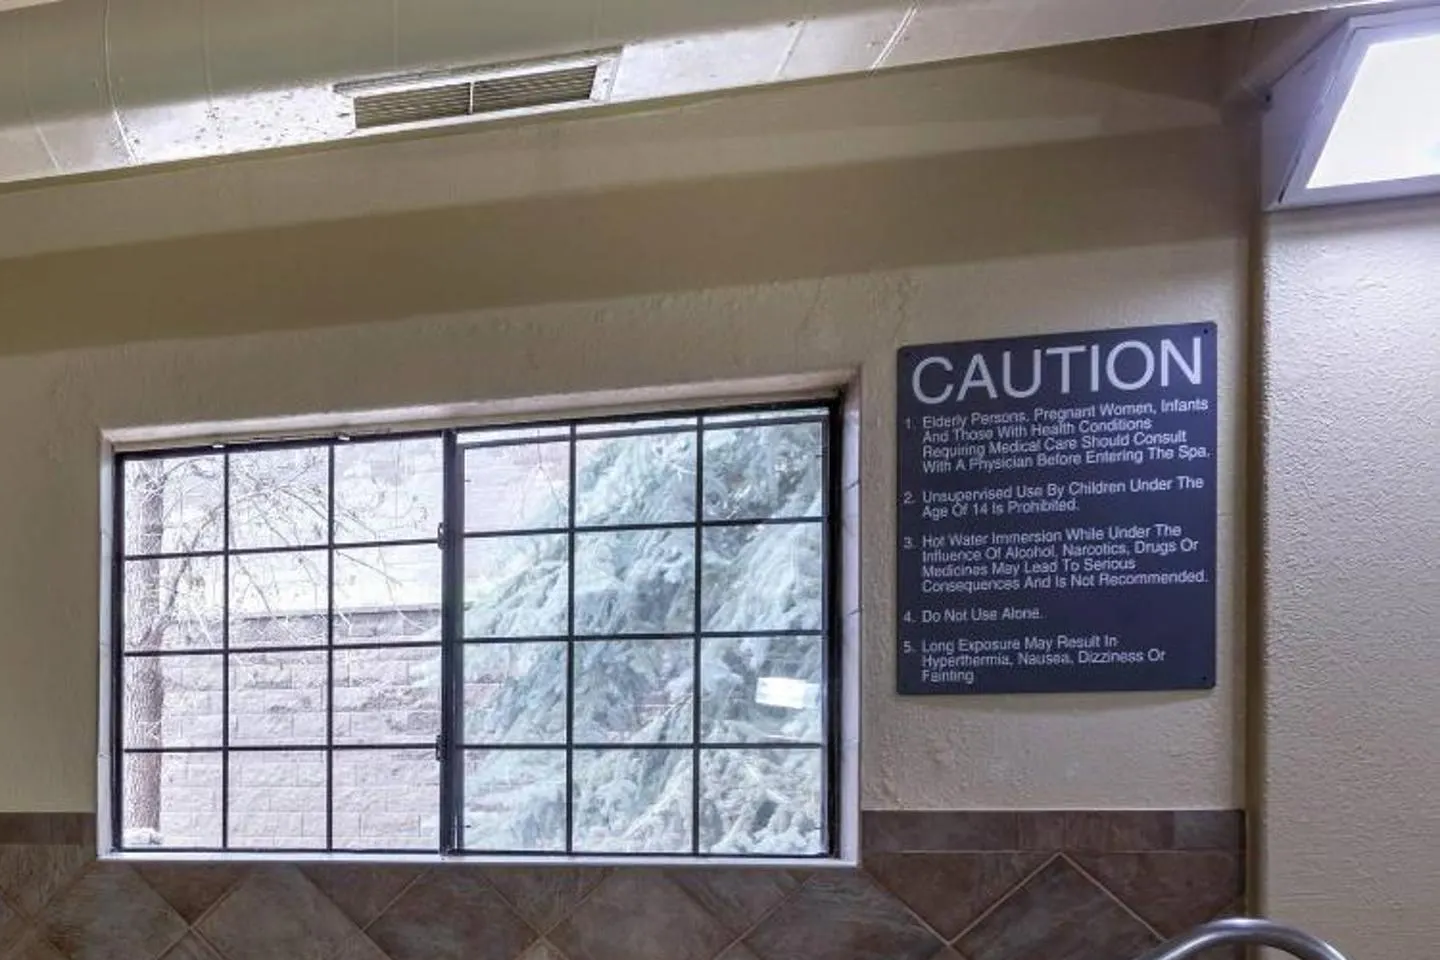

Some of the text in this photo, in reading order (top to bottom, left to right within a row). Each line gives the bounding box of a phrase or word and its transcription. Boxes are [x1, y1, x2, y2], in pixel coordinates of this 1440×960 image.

[912, 337, 1201, 404] CAUTION
[922, 415, 967, 429] Elderly
[1033, 405, 1096, 421] Pregnant
[1161, 398, 1208, 412] Infants
[922, 418, 1153, 443] And Those With Health Conditions
[922, 430, 1187, 459] Requiring Medical Care Should Consult
[922, 459, 951, 473] With
[956, 459, 966, 471] A
[969, 456, 1033, 472] Physician
[1037, 453, 1082, 467] Before
[1086, 449, 1143, 464] Entering
[1148, 447, 1174, 460] The
[922, 486, 1012, 505] Unsupervised
[1017, 485, 1043, 498] Use
[1047, 483, 1065, 499] By
[1069, 480, 1126, 495] Children
[1130, 478, 1172, 492] Under
[1176, 476, 1205, 489] The
[922, 505, 949, 521] Age
[951, 503, 969, 517] Of
[973, 503, 988, 515] 14
[992, 503, 1004, 515] Is
[922, 535, 945, 548] Hot
[948, 533, 989, 546] Water
[992, 530, 1062, 544] Immersion
[1066, 527, 1105, 541] While
[1108, 526, 1151, 540] Under
[1155, 523, 1182, 537] The
[922, 549, 982, 563] Influence
[985, 546, 1001, 560] Of
[1134, 540, 1177, 556] Drugs
[1180, 537, 1199, 552] Or
[922, 557, 1136, 578] Medicines May Lead To Serious
[922, 577, 1020, 594] Consequences
[1023, 575, 1051, 589] And
[1056, 575, 1067, 588] Is
[1071, 573, 1095, 587] Not
[922, 609, 941, 623] Do
[943, 608, 967, 622] Not
[970, 607, 998, 621] Use
[921, 640, 955, 655] Long
[958, 638, 1020, 653] Exposure
[1024, 636, 1052, 652] May
[1057, 635, 1100, 649] Result
[1105, 634, 1118, 647] In
[1078, 650, 1144, 663] Dizziness
[1147, 648, 1166, 661] Or
[921, 669, 974, 684] Fainting
